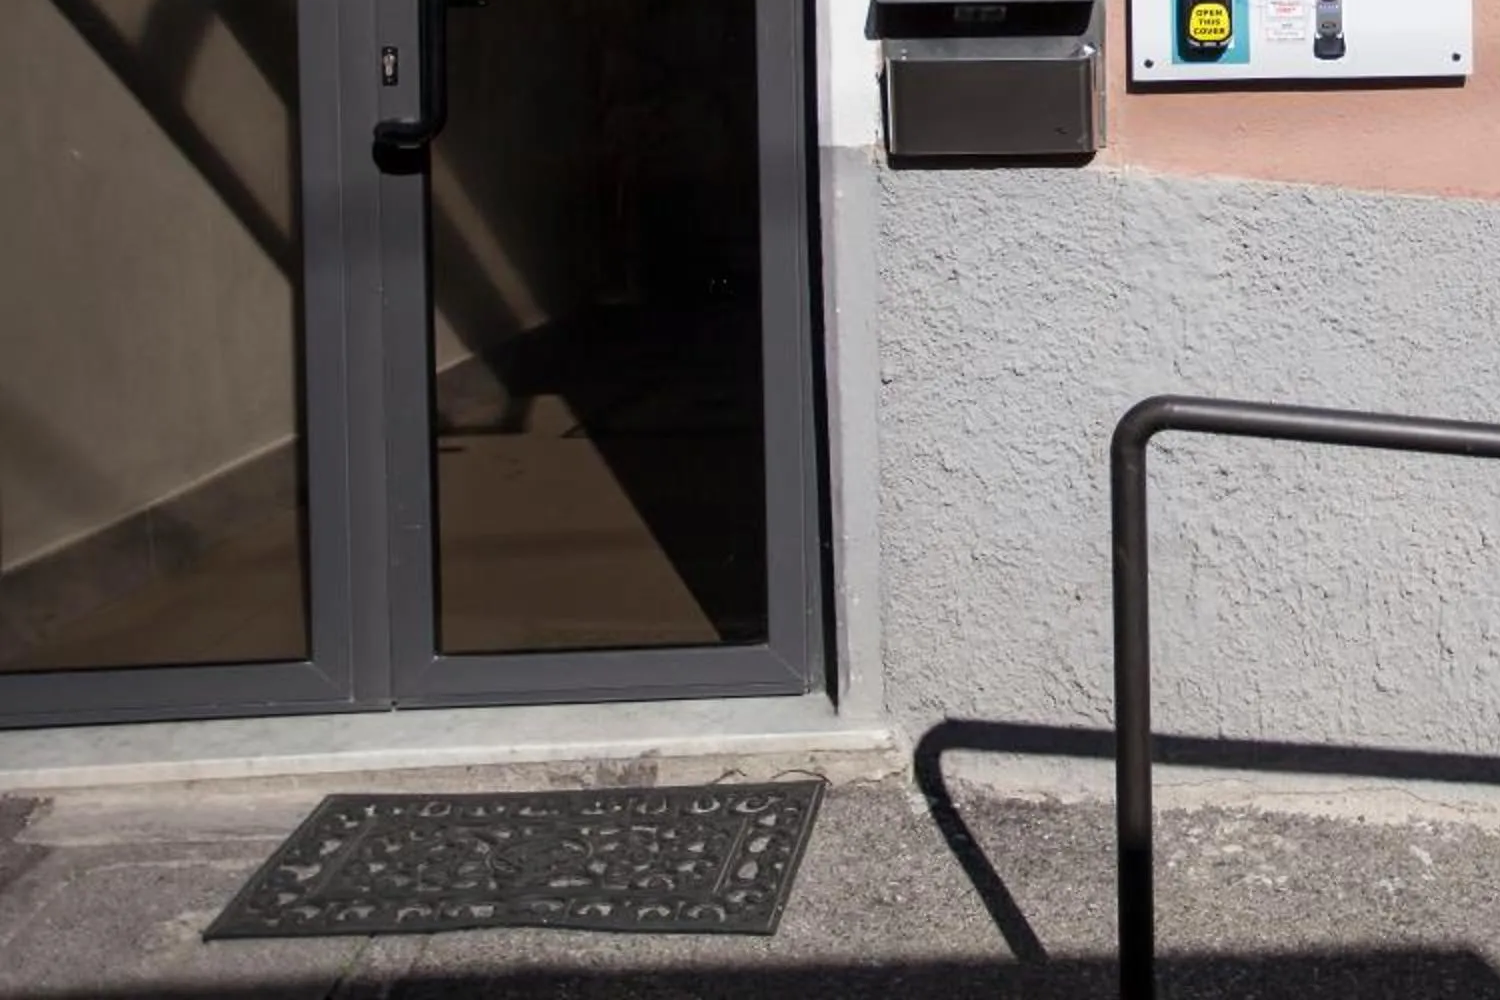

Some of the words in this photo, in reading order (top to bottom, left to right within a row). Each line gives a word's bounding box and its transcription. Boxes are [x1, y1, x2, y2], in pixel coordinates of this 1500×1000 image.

[1195, 9, 1223, 17] OPEN
[1198, 18, 1221, 26] THIS
[1193, 27, 1225, 35] COVER
